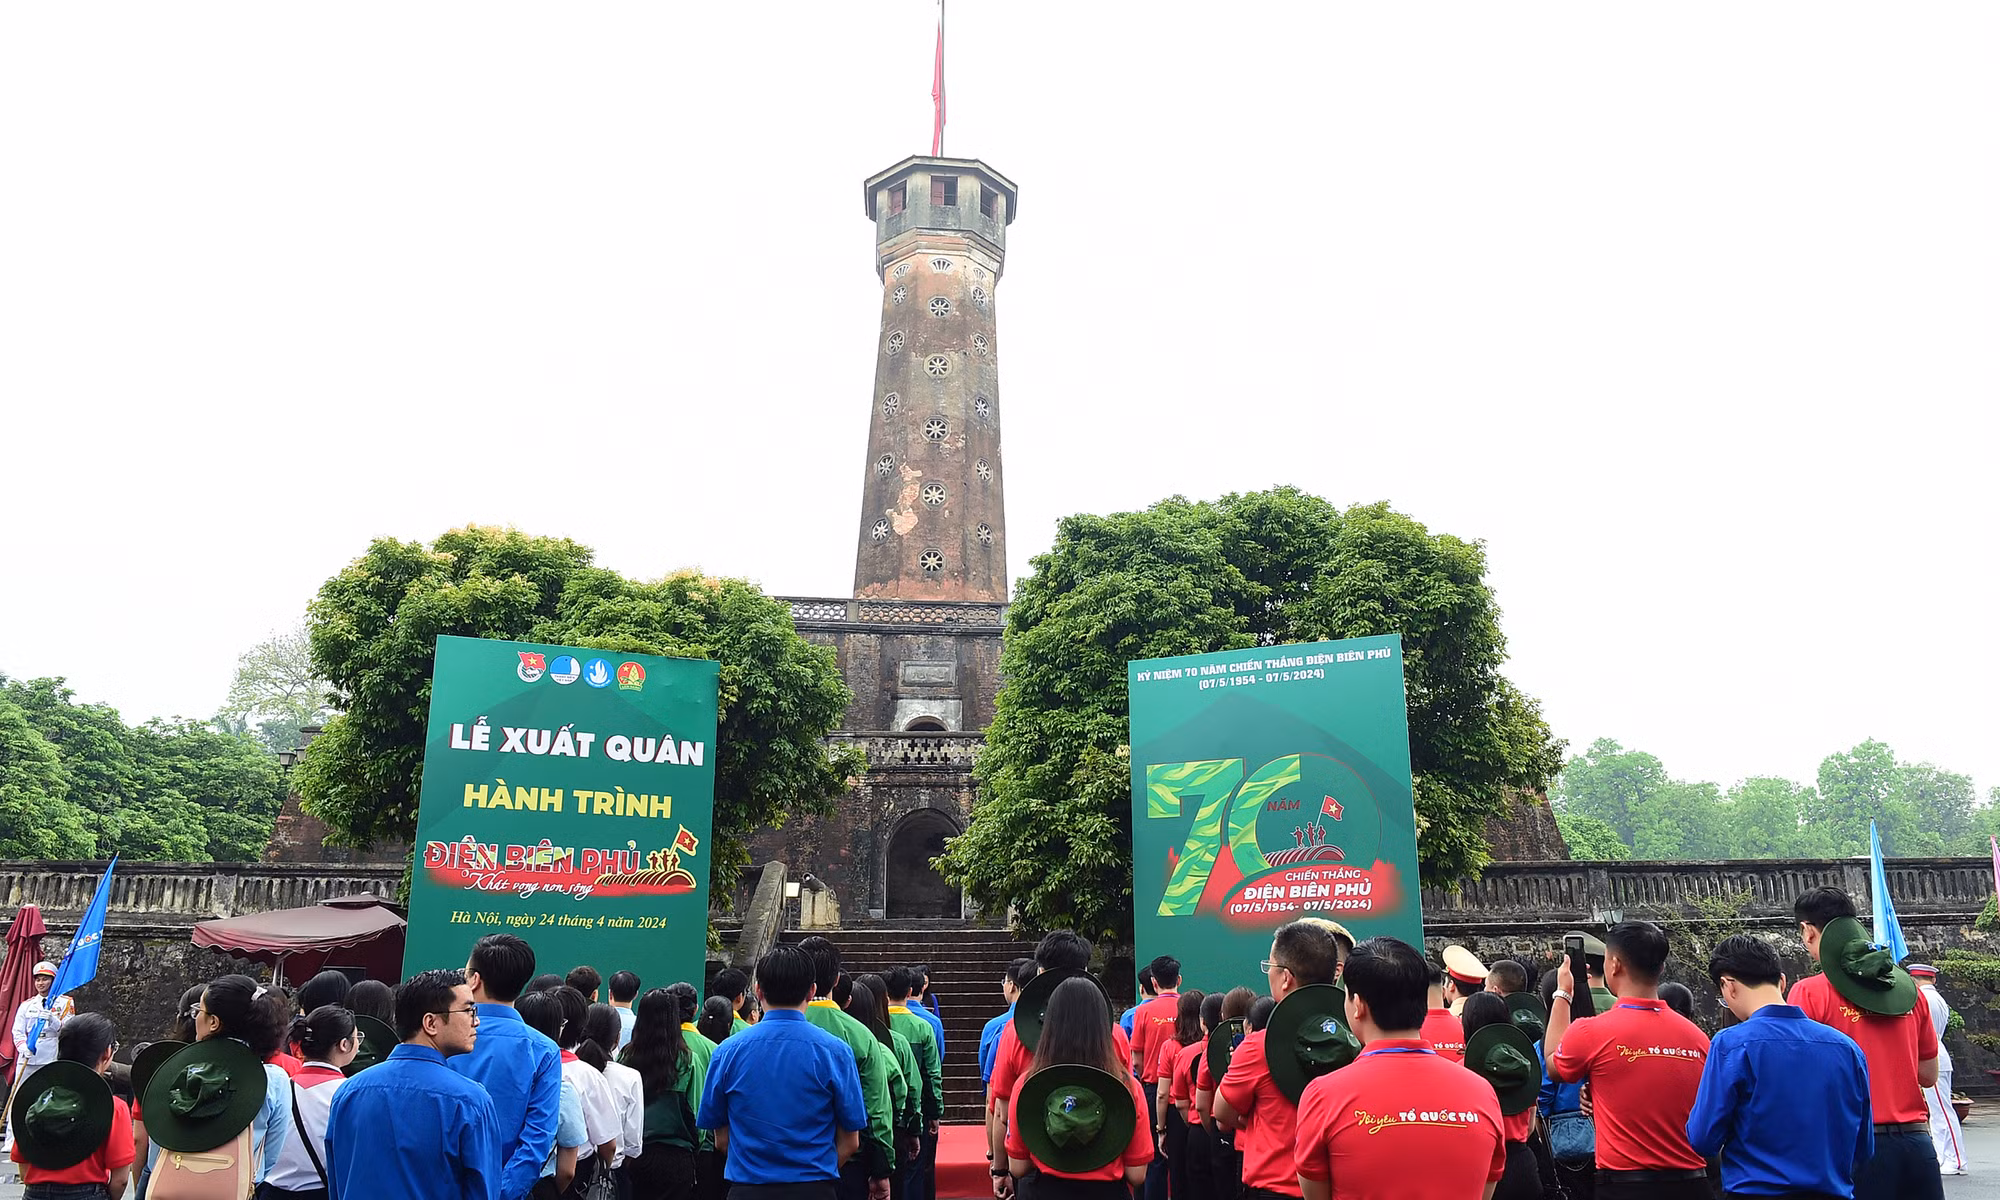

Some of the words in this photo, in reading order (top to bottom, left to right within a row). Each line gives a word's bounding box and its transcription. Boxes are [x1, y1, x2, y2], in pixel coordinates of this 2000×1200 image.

[1153, 668, 1182, 681] NIỆM
[1184, 667, 1198, 677] 70
[1200, 663, 1227, 676] NĂM
[1229, 658, 1262, 673] CHIẾN
[1265, 655, 1303, 669] THẮNG
[1305, 652, 1334, 666] ĐIỆN
[1336, 649, 1365, 662] BIÊN
[1367, 646, 1391, 660] PHỦ
[1199, 675, 1256, 691] (07/5/1954
[1265, 668, 1325, 683] 07/5/2024)
[449, 716, 491, 751] LỄ
[499, 723, 596, 758] XUẤT
[604, 734, 705, 767] QUÂN
[463, 778, 564, 812] HÀNH
[573, 786, 673, 819] TRÌNH
[1267, 798, 1301, 812] NĂM
[1146, 753, 1304, 917] 70
[424, 835, 499, 878] ĐIỆN
[505, 839, 574, 875] BIÊN
[580, 840, 642, 876] PHỦ
[1285, 869, 1319, 881] CHIẾN
[1322, 867, 1361, 880] THẮNG
[464, 871, 510, 890] Khát
[512, 882, 541, 899] vọng
[542, 883, 565, 893] non
[563, 882, 595, 901] sông
[1244, 884, 1286, 902] ĐIỆN
[1289, 882, 1331, 899] BIÊN
[1334, 878, 1372, 896] PHỦ
[1303, 898, 1373, 911] 07/5/2024)
[450, 911, 471, 924] Hà
[474, 911, 502, 926] Nội,
[506, 915, 536, 928] ngày
[539, 914, 555, 926] 24
[558, 914, 593, 929] tháng
[597, 915, 605, 926] 4
[607, 917, 634, 928] năm
[637, 916, 667, 928] 2024
[1648, 1045, 1660, 1054] TỔ
[1662, 1047, 1687, 1056] QUỐC
[1688, 1050, 1701, 1058] TÔI
[1399, 1108, 1416, 1122] TỔ
[1420, 1109, 1456, 1122] QUỐC
[1458, 1111, 1479, 1123] TÔI
